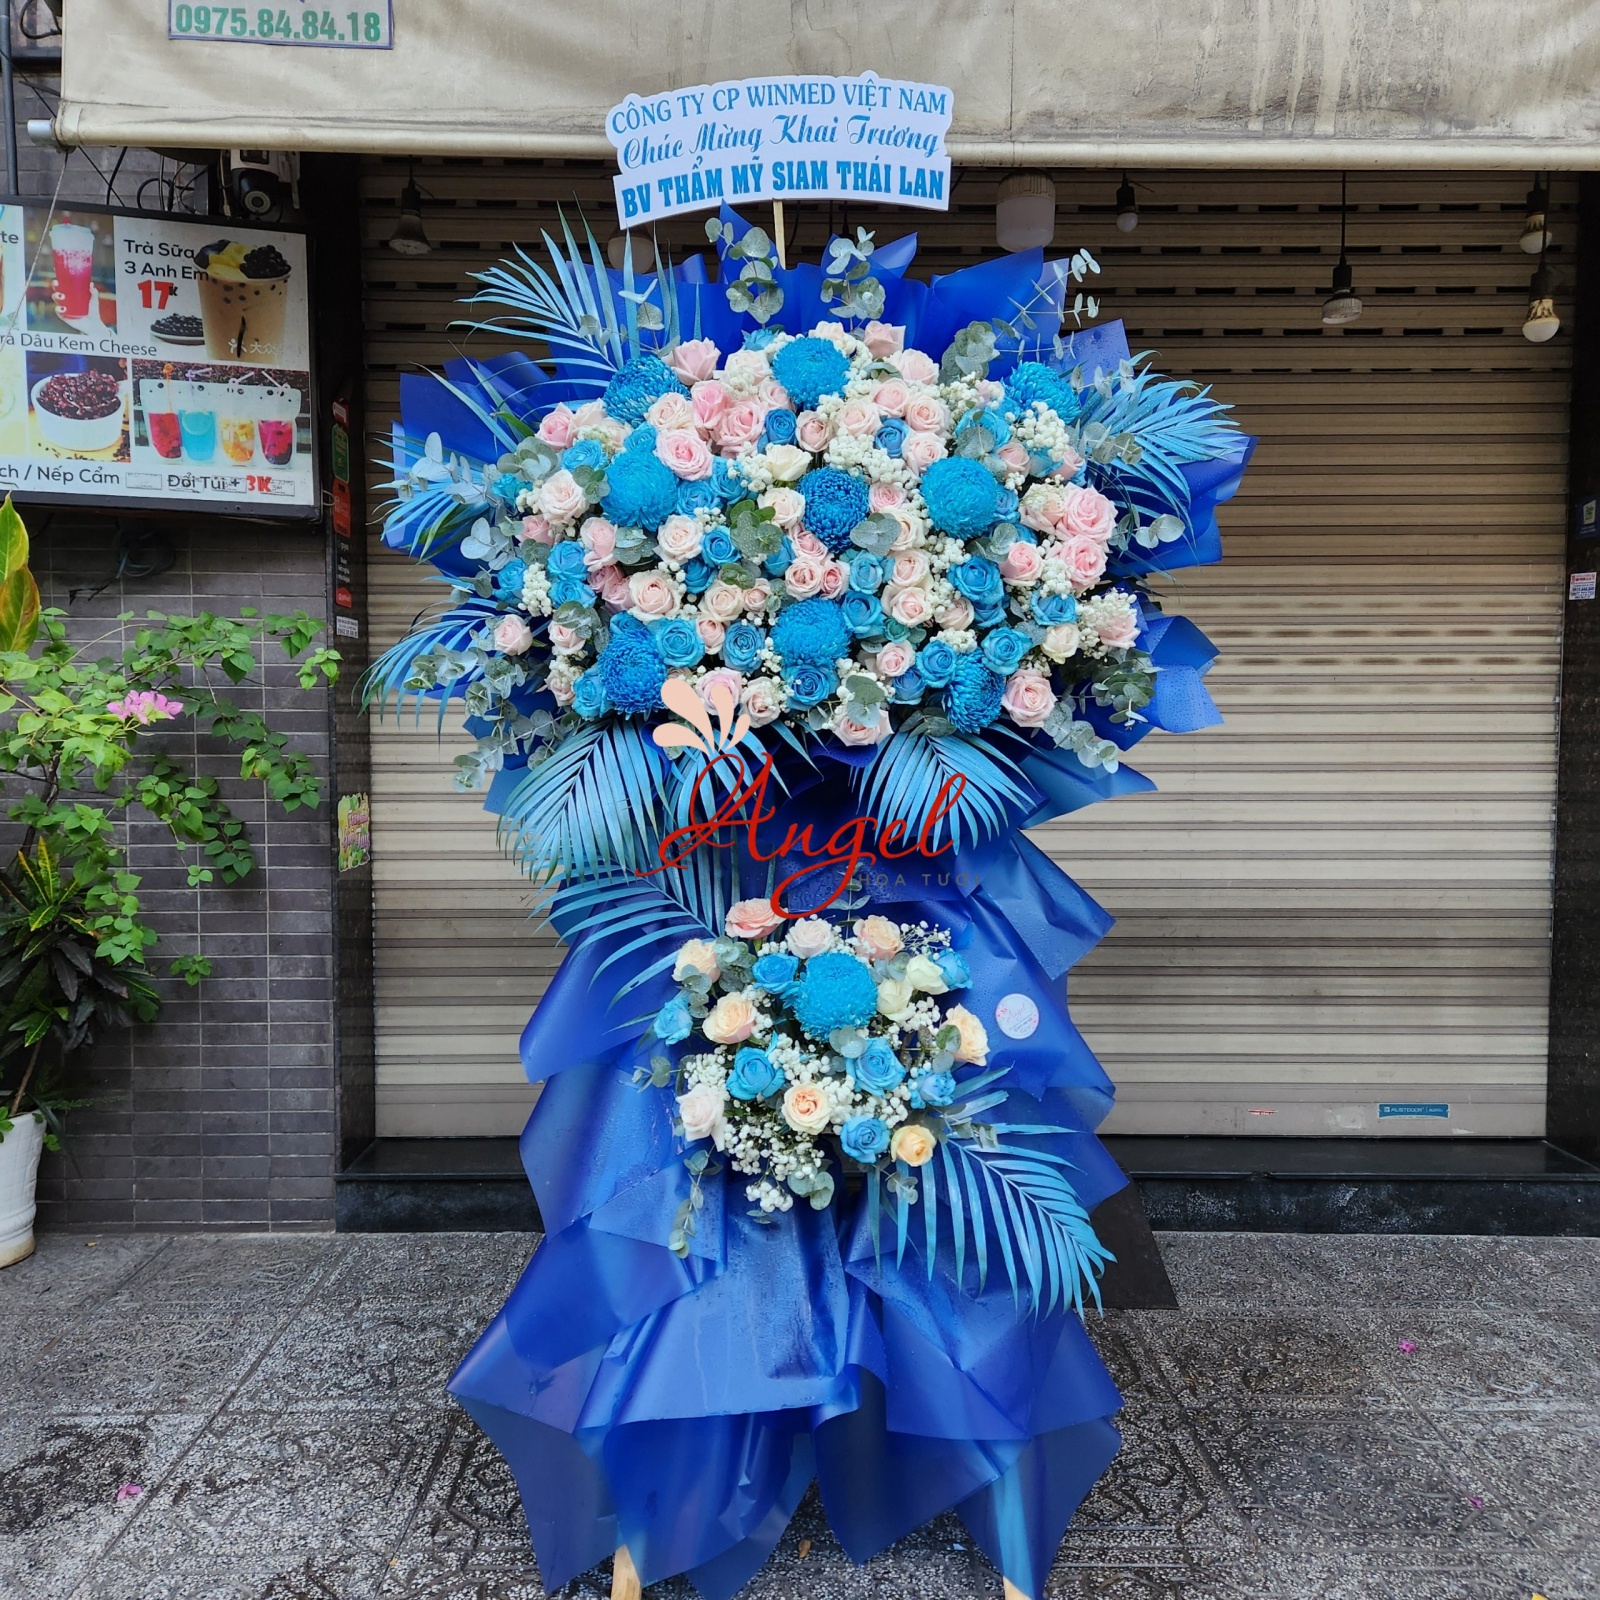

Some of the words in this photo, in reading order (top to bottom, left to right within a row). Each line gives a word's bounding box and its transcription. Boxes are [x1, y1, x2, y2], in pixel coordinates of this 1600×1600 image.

[175, 4, 380, 42] 0975.84.84.18
[612, 101, 672, 134] CÔNG
[677, 93, 704, 118] TY
[713, 87, 740, 111] CP
[746, 83, 836, 108] WINMED
[842, 78, 891, 112] VIỆT
[898, 88, 947, 116] NAM
[623, 134, 685, 169] Chúc
[689, 121, 764, 153] Mừng
[769, 114, 838, 144] Khai
[846, 114, 939, 158] Trương
[621, 182, 651, 219] BV
[658, 155, 724, 208] THẨM
[731, 155, 764, 195] MỸ
[772, 160, 829, 191] SIAM
[836, 155, 891, 194] THÁI
[898, 165, 944, 200] LAN
[124, 239, 153, 255] Trà
[158, 242, 195, 259] Sữa
[124, 261, 136, 274] 3
[141, 262, 177, 279] Anh
[181, 267, 209, 281] Em
[20, 333, 53, 348] Dâu
[59, 336, 95, 352] Kem
[99, 339, 157, 356] Cheese
[37, 465, 74, 485] Nếp
[79, 466, 120, 484] Cẩm
[167, 472, 196, 488] Đổi
[245, 475, 272, 493] 3K
